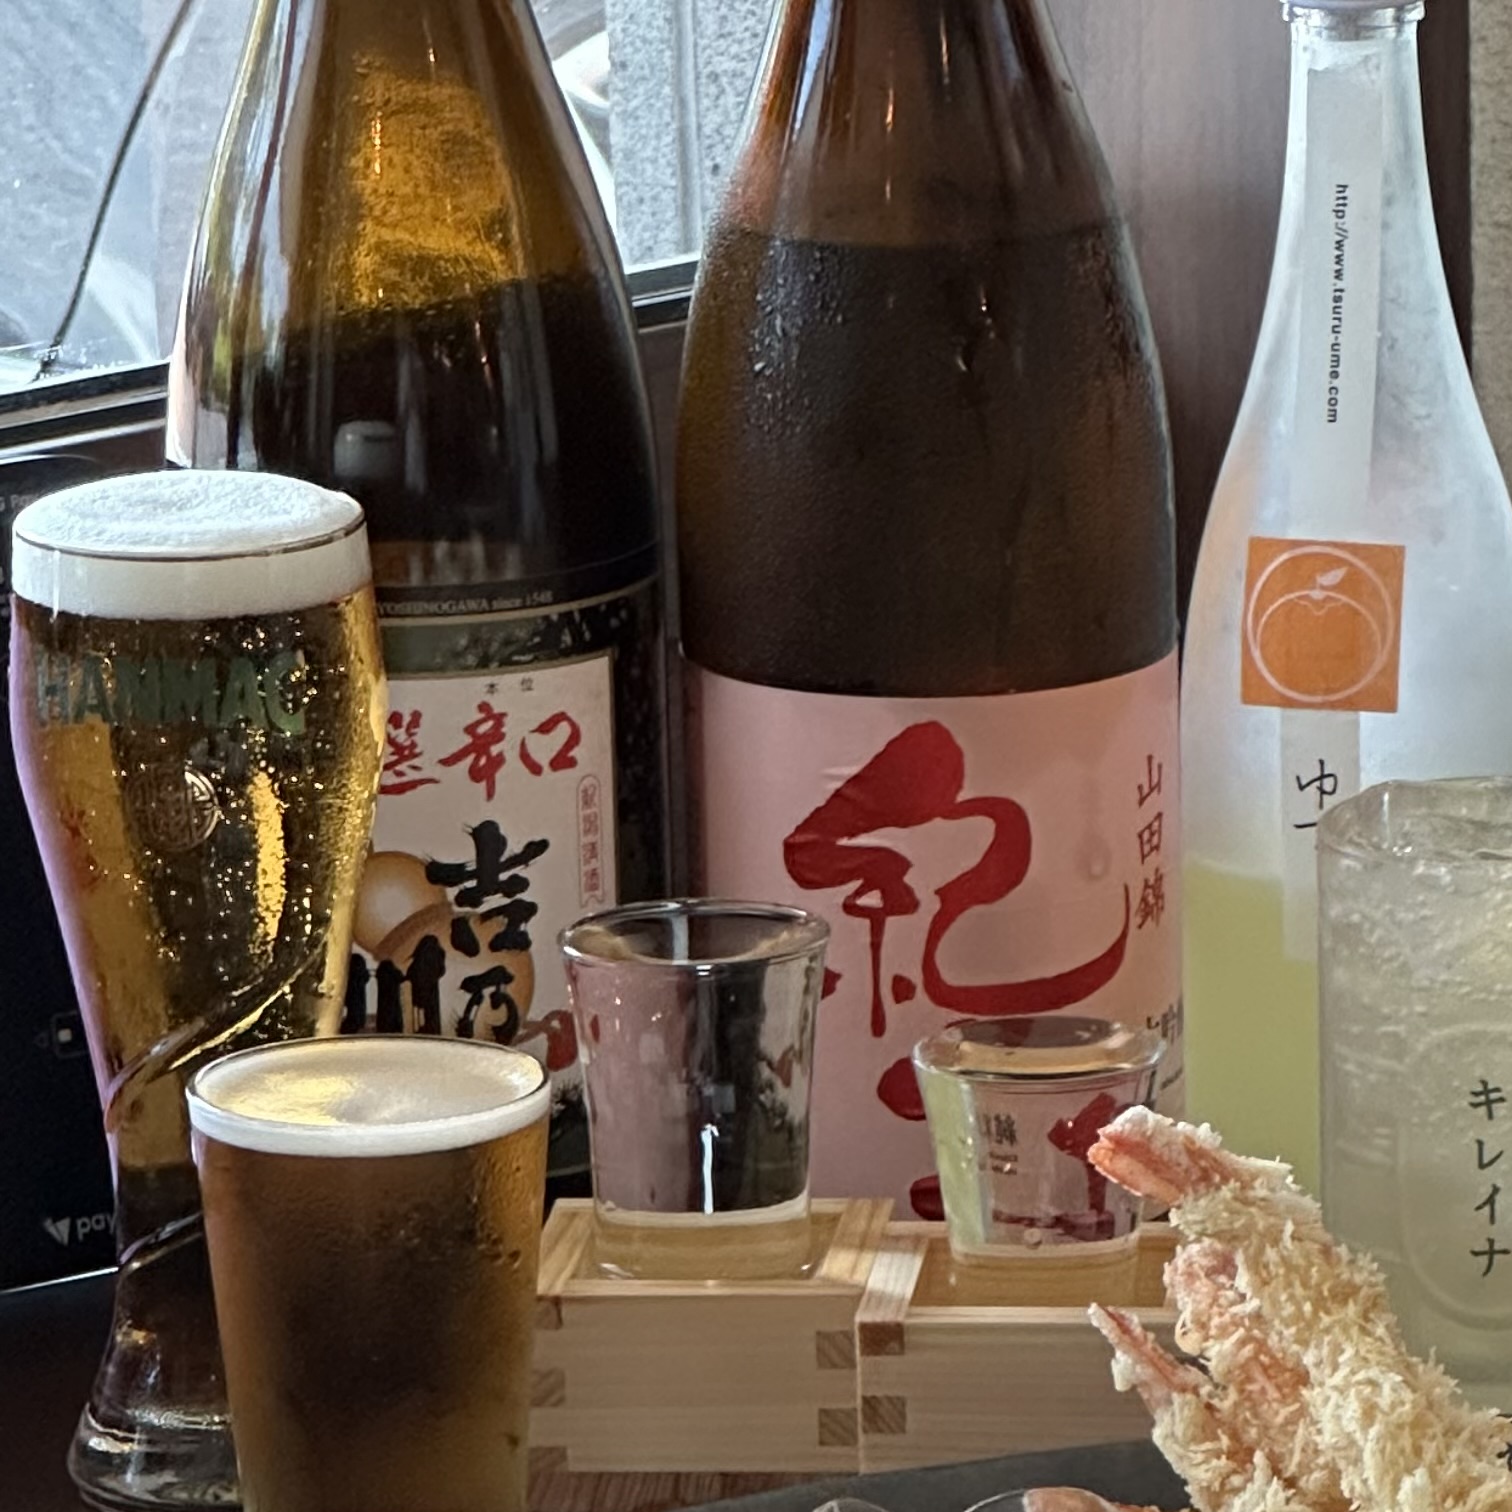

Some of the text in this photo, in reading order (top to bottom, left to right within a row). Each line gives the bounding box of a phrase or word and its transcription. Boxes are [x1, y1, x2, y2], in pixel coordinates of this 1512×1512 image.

[1327, 183, 1349, 424] http://www.tsuru-ume.com
[1136, 754, 1166, 930] 山田錦
[1293, 758, 1338, 829] ゆ
[1467, 1078, 1512, 1278] キレイナ
